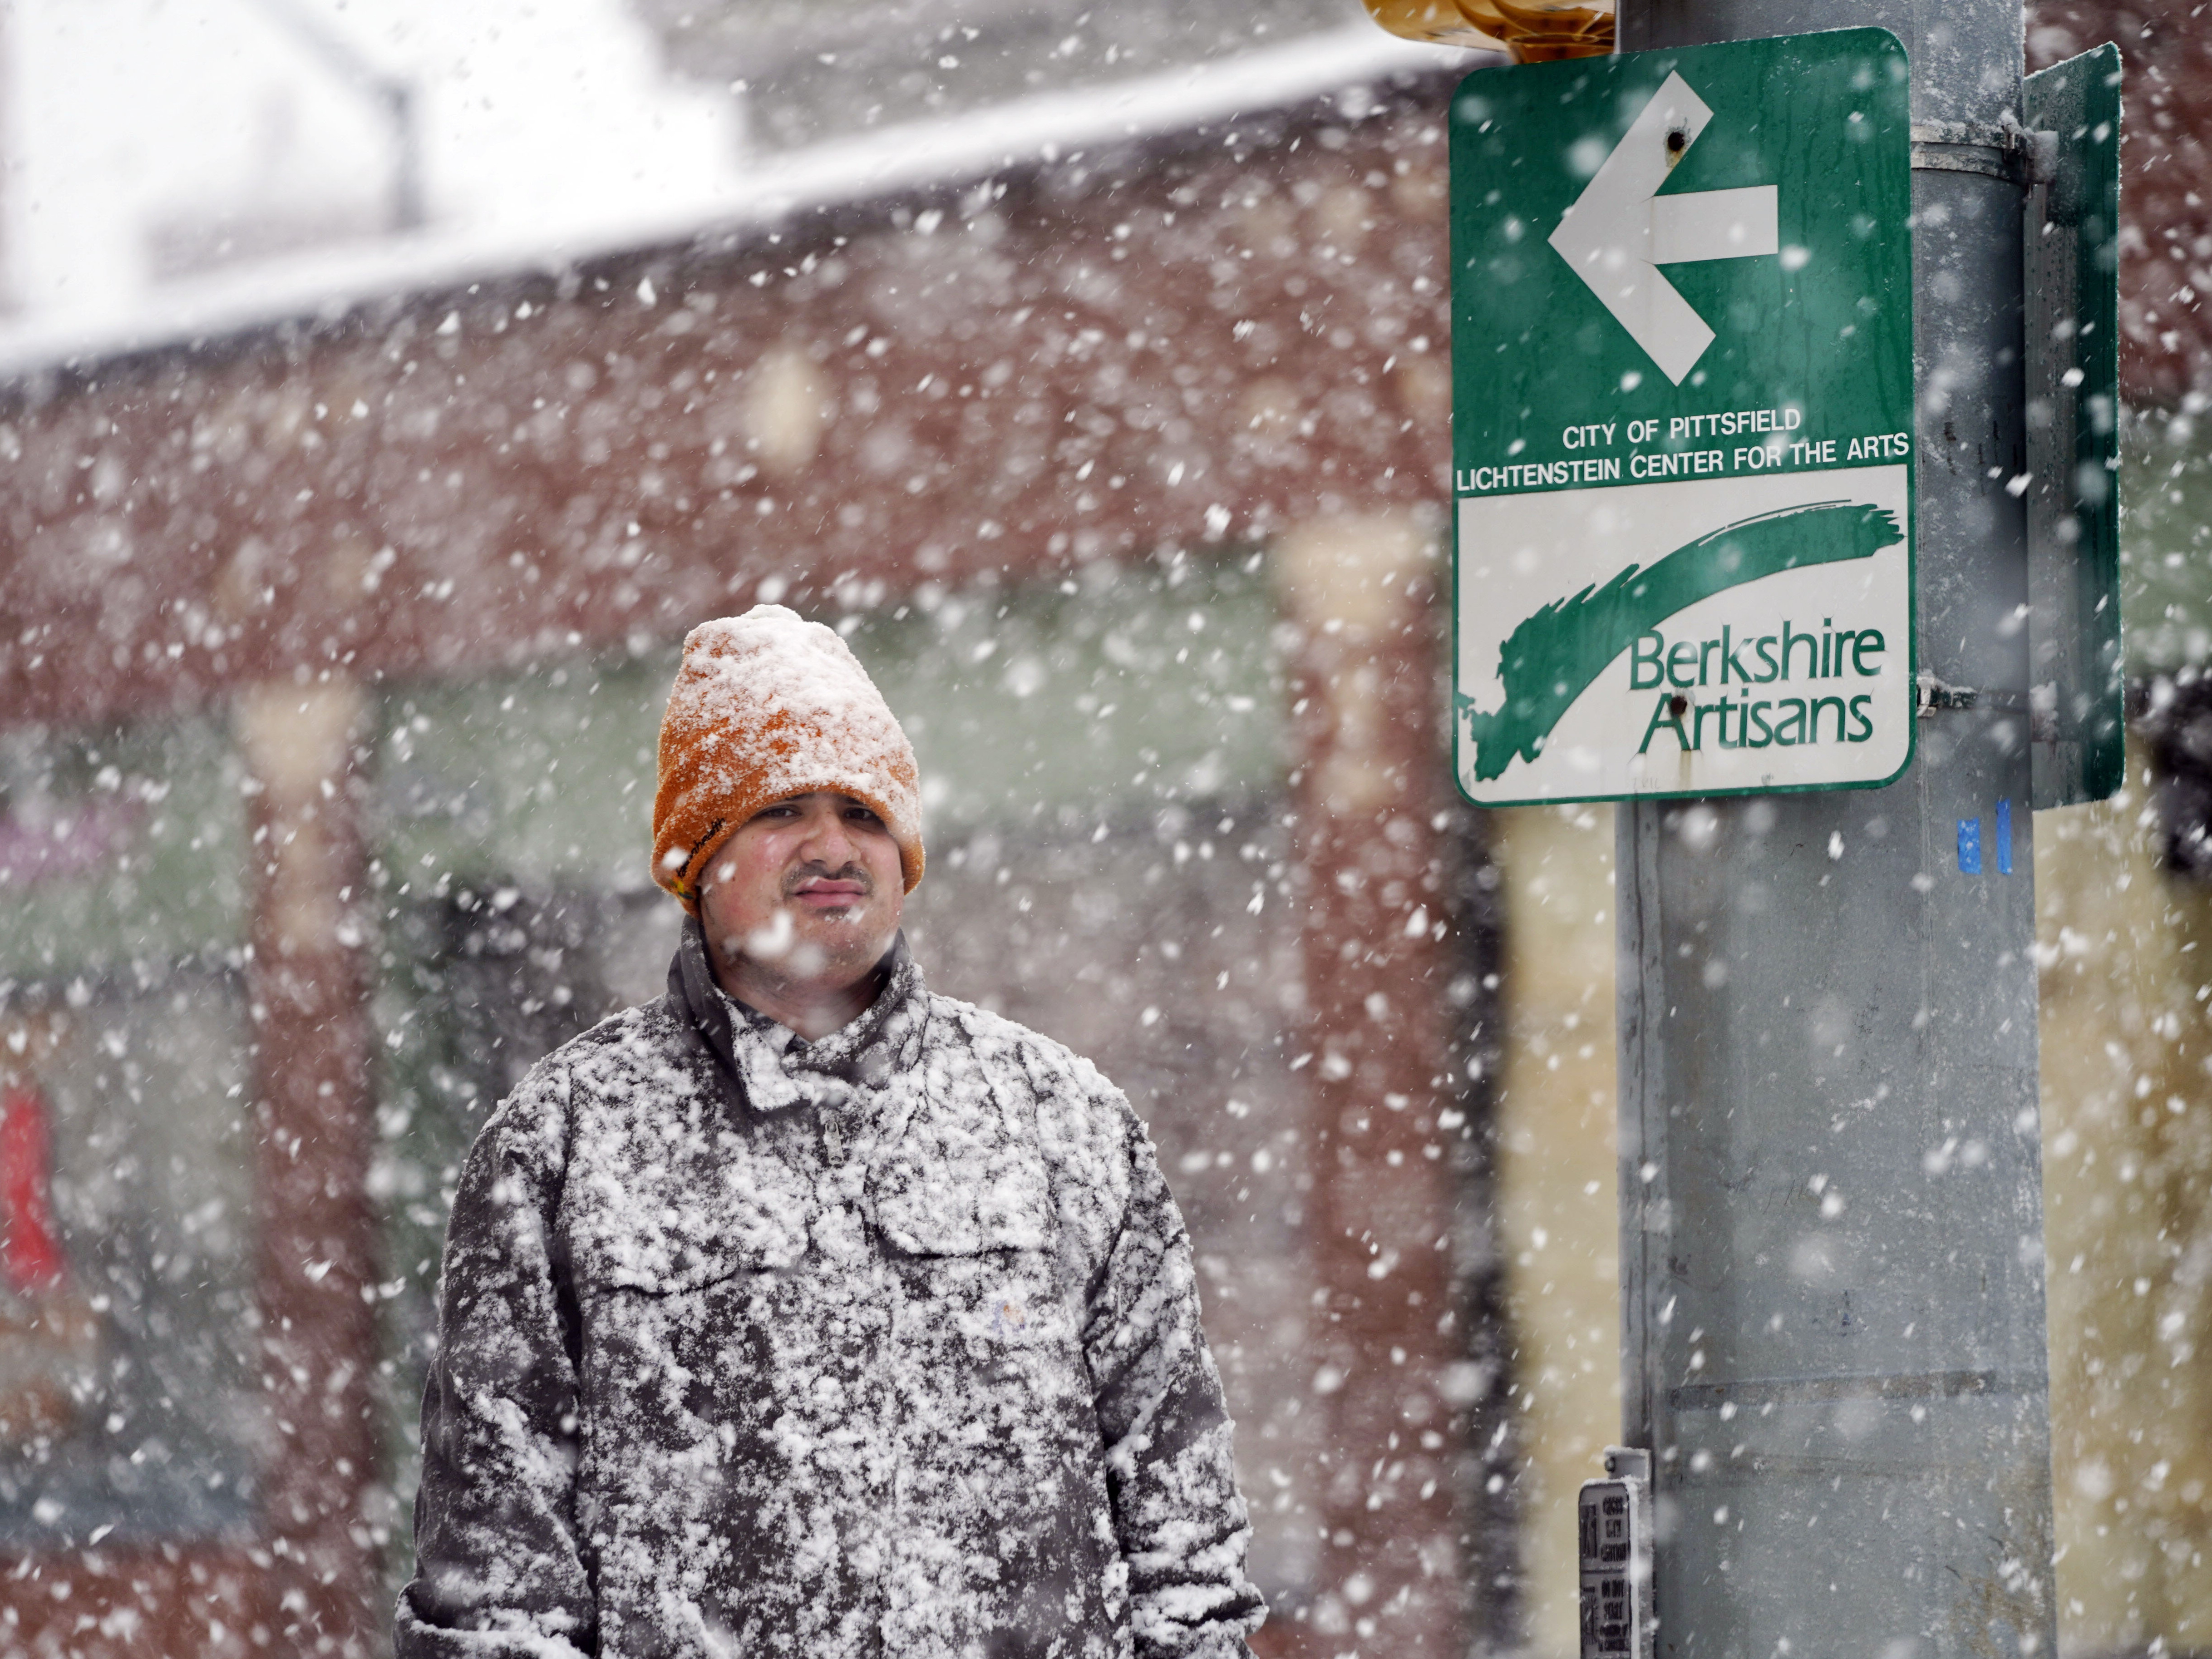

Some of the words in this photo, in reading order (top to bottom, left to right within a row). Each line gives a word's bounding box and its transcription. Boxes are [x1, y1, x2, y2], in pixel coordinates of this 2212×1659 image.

[1562, 423, 1616, 449] CITY
[1627, 419, 1659, 444] OF
[1670, 408, 1801, 439] PITTSFIELD
[1457, 458, 1620, 491] LICHTENSTEIN
[1630, 449, 1724, 479] CENTER
[1734, 445, 1782, 470] FOR
[1789, 439, 1837, 465] THE
[1847, 432, 1909, 460] ARTS
[1629, 617, 1886, 691] Berkshire
[1638, 687, 1873, 754] Artisans
